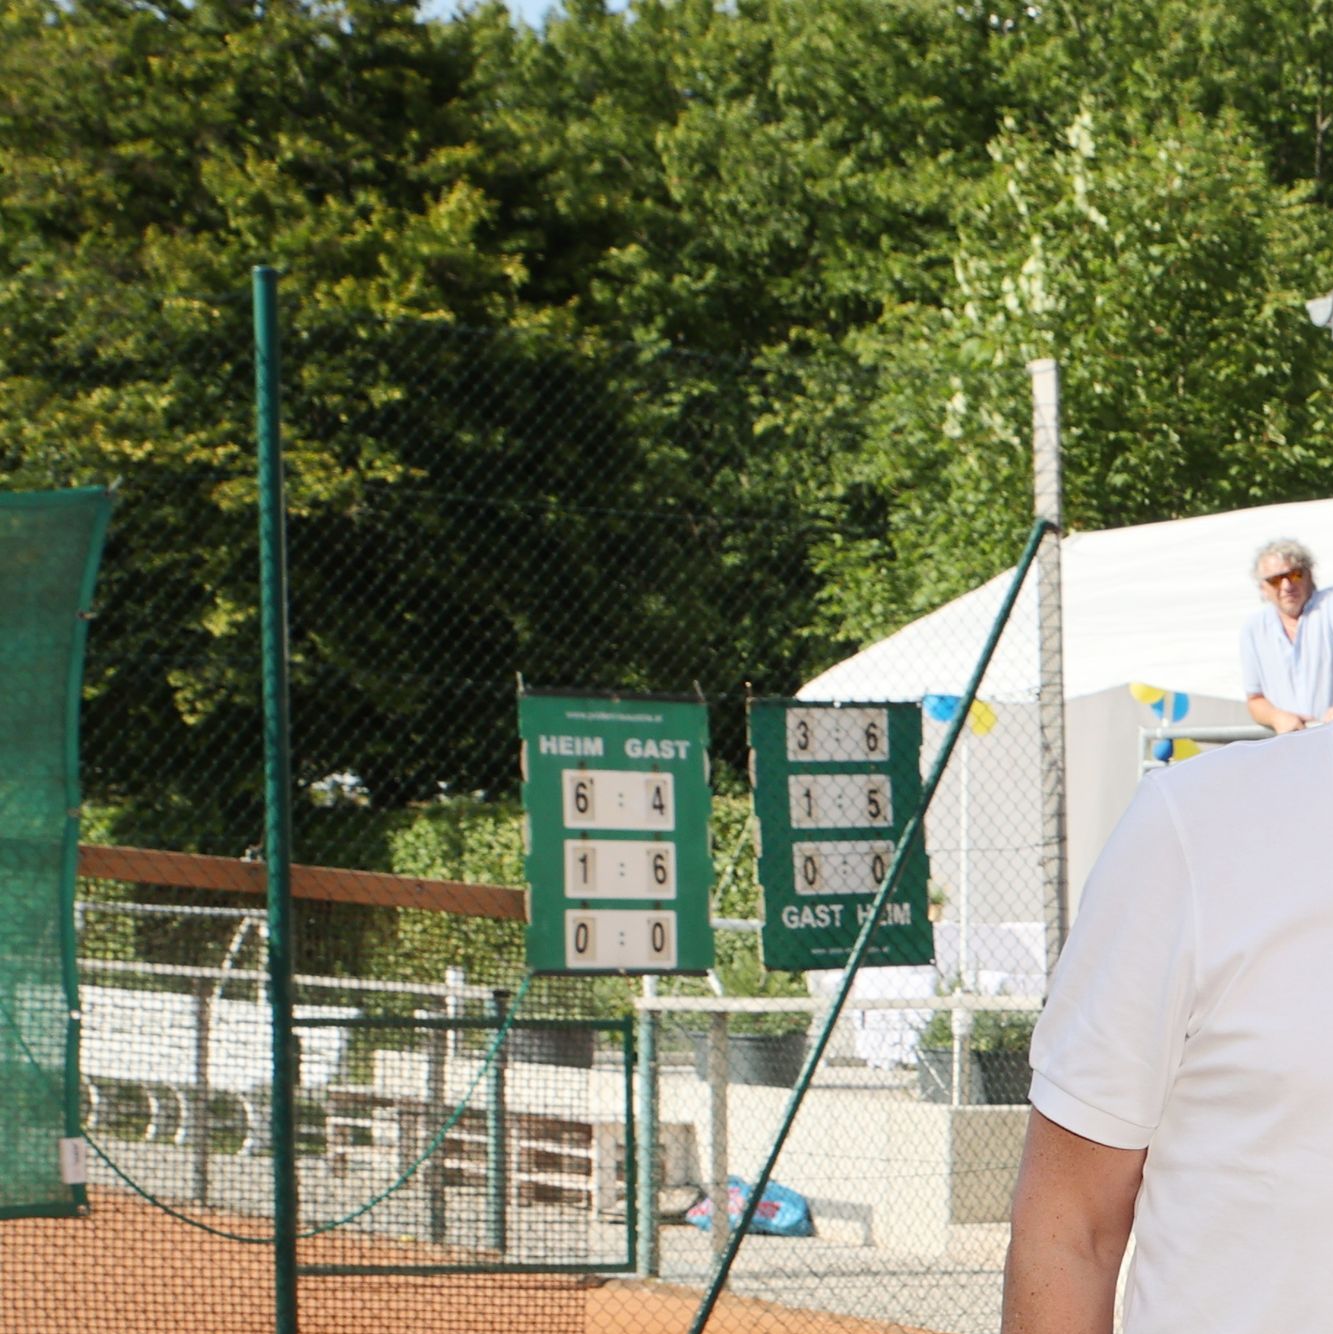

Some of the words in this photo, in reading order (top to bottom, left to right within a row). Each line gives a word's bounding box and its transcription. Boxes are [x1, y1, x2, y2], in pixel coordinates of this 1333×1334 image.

[538, 734, 604, 757] HEIM
[624, 737, 691, 760] GAST
[796, 720, 809, 751] 3
[864, 722, 878, 752] 6
[575, 781, 589, 814] 6
[652, 785, 665, 816] 4
[803, 787, 812, 818] 1
[866, 788, 881, 819] 5
[578, 852, 588, 885] 1
[652, 853, 667, 885] 6
[803, 855, 817, 886] 0
[871, 854, 885, 885] 0
[781, 903, 844, 929] GAST
[856, 901, 912, 927] HIM
[575, 922, 589, 954] 0
[651, 921, 666, 953] 0
